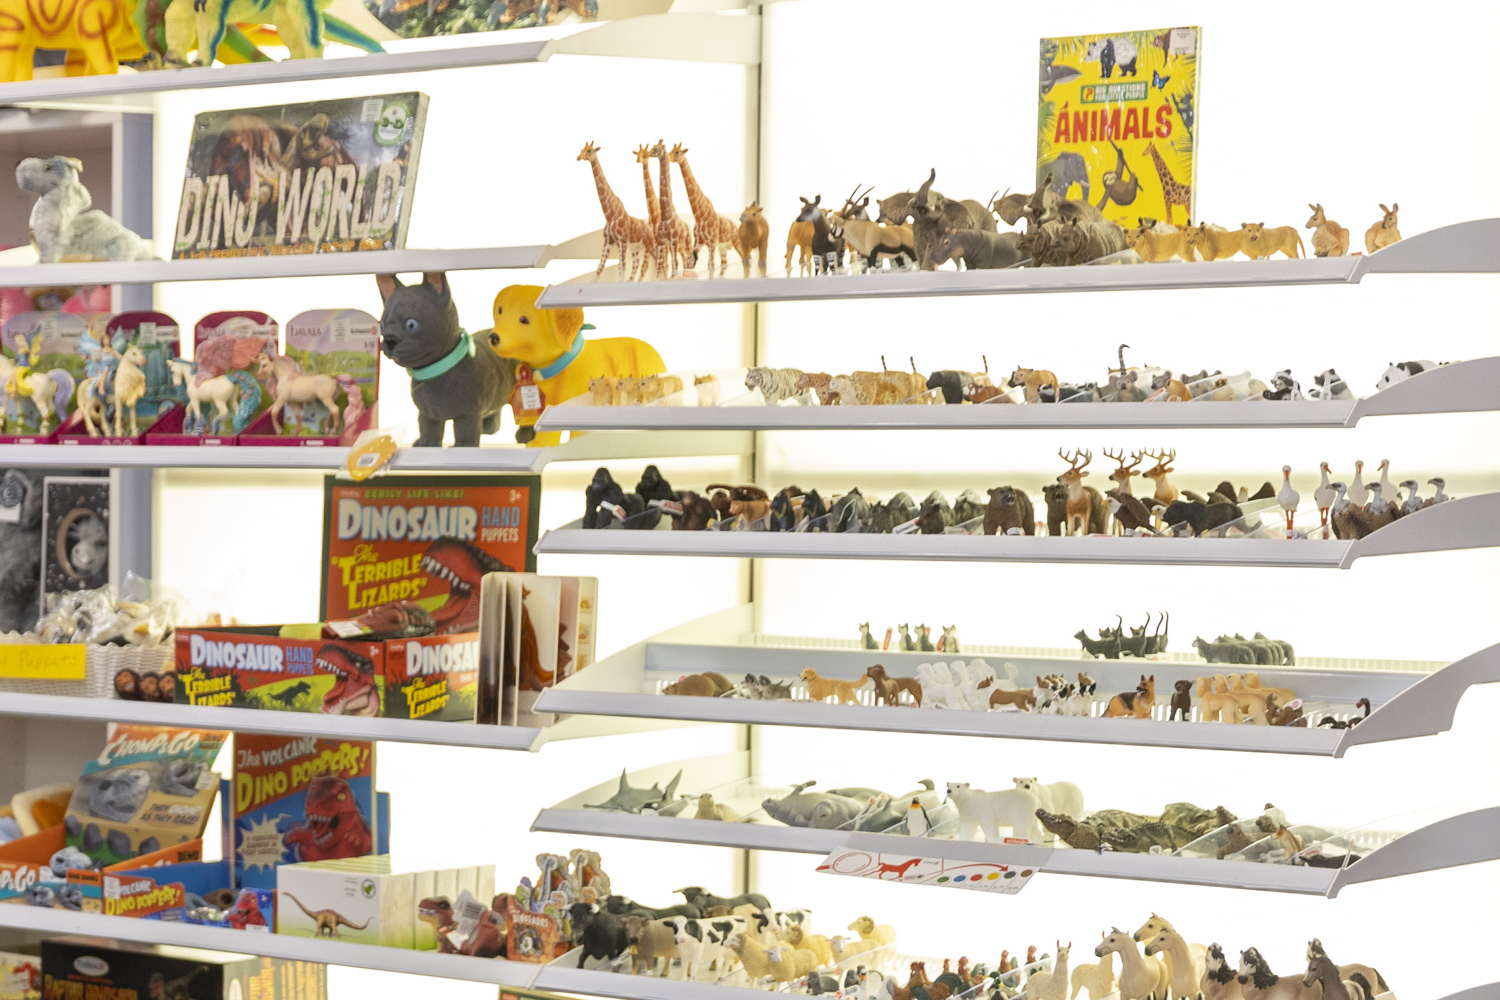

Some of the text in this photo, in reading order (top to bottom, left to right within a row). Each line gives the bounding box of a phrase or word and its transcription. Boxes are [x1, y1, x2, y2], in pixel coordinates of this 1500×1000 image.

[1054, 105, 1173, 144] ANIMALS
[276, 161, 402, 245] WORLD
[337, 498, 521, 542] DINOSAUR HAND
[480, 528, 520, 543] PUPPETS
[190, 635, 285, 673] DINOSAUR
[262, 736, 318, 767] VOLCANIC
[236, 769, 288, 813] DINO
[105, 896, 136, 915] DINO
